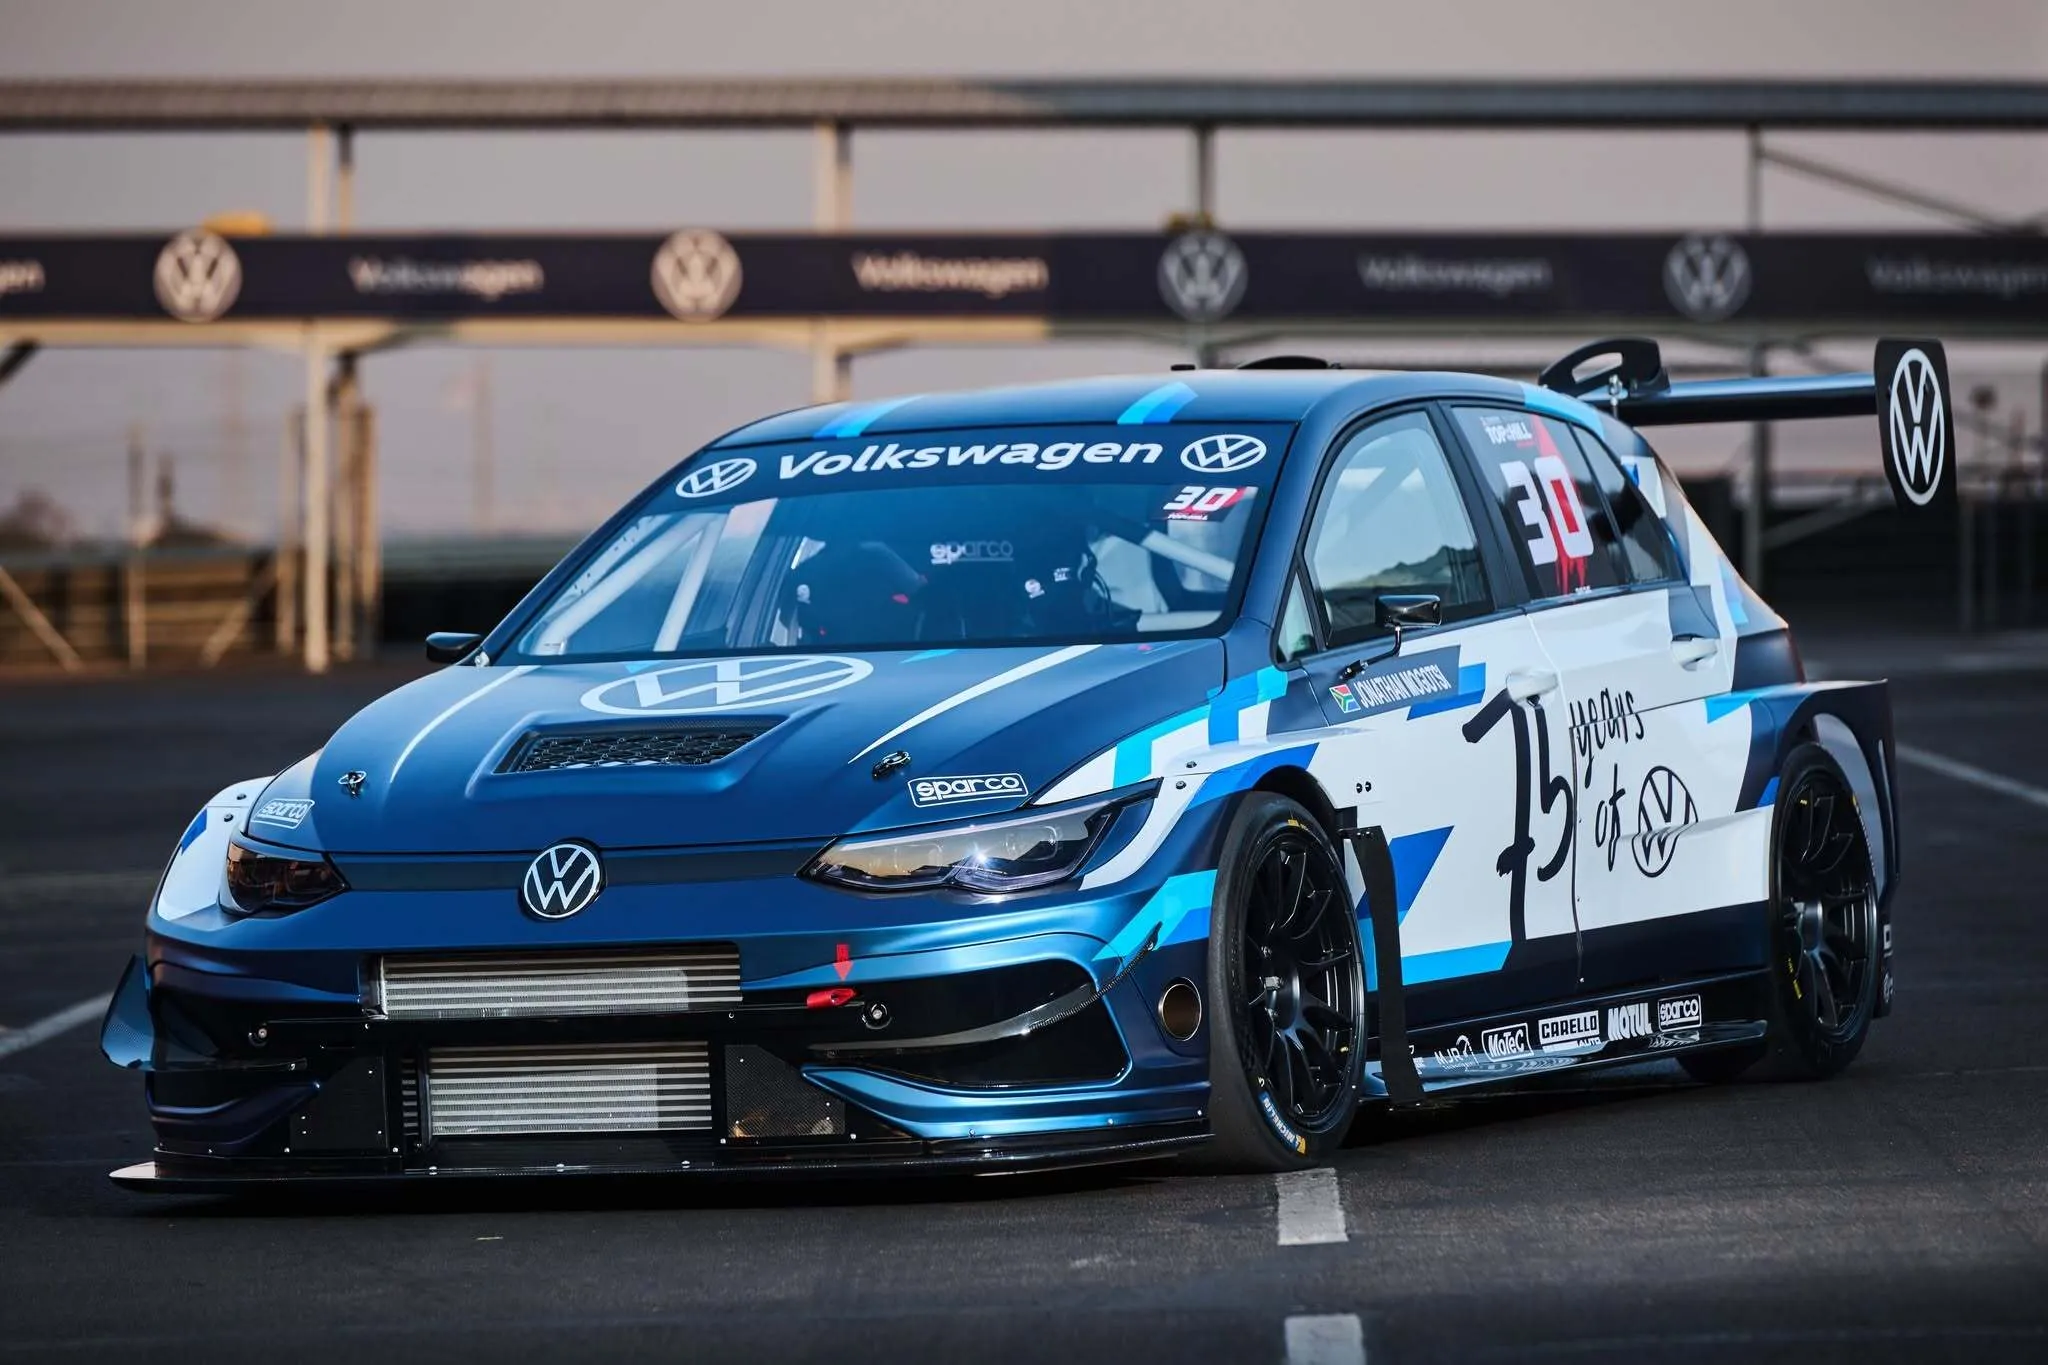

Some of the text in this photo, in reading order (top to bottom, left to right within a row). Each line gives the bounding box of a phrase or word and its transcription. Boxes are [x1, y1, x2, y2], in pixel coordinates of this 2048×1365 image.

[778, 436, 1164, 480] Volkswagen
[1163, 486, 1238, 512] 30
[1500, 455, 1594, 565] 30
[1354, 671, 1411, 708] JONATHAN
[916, 776, 1023, 802] sparco
[1462, 686, 1645, 941] 75 years
[1595, 763, 1626, 872] of
[1541, 1015, 1598, 1039] CARELLO
[1607, 1003, 1653, 1041] MOTUL
[1659, 999, 1699, 1026] sparco
